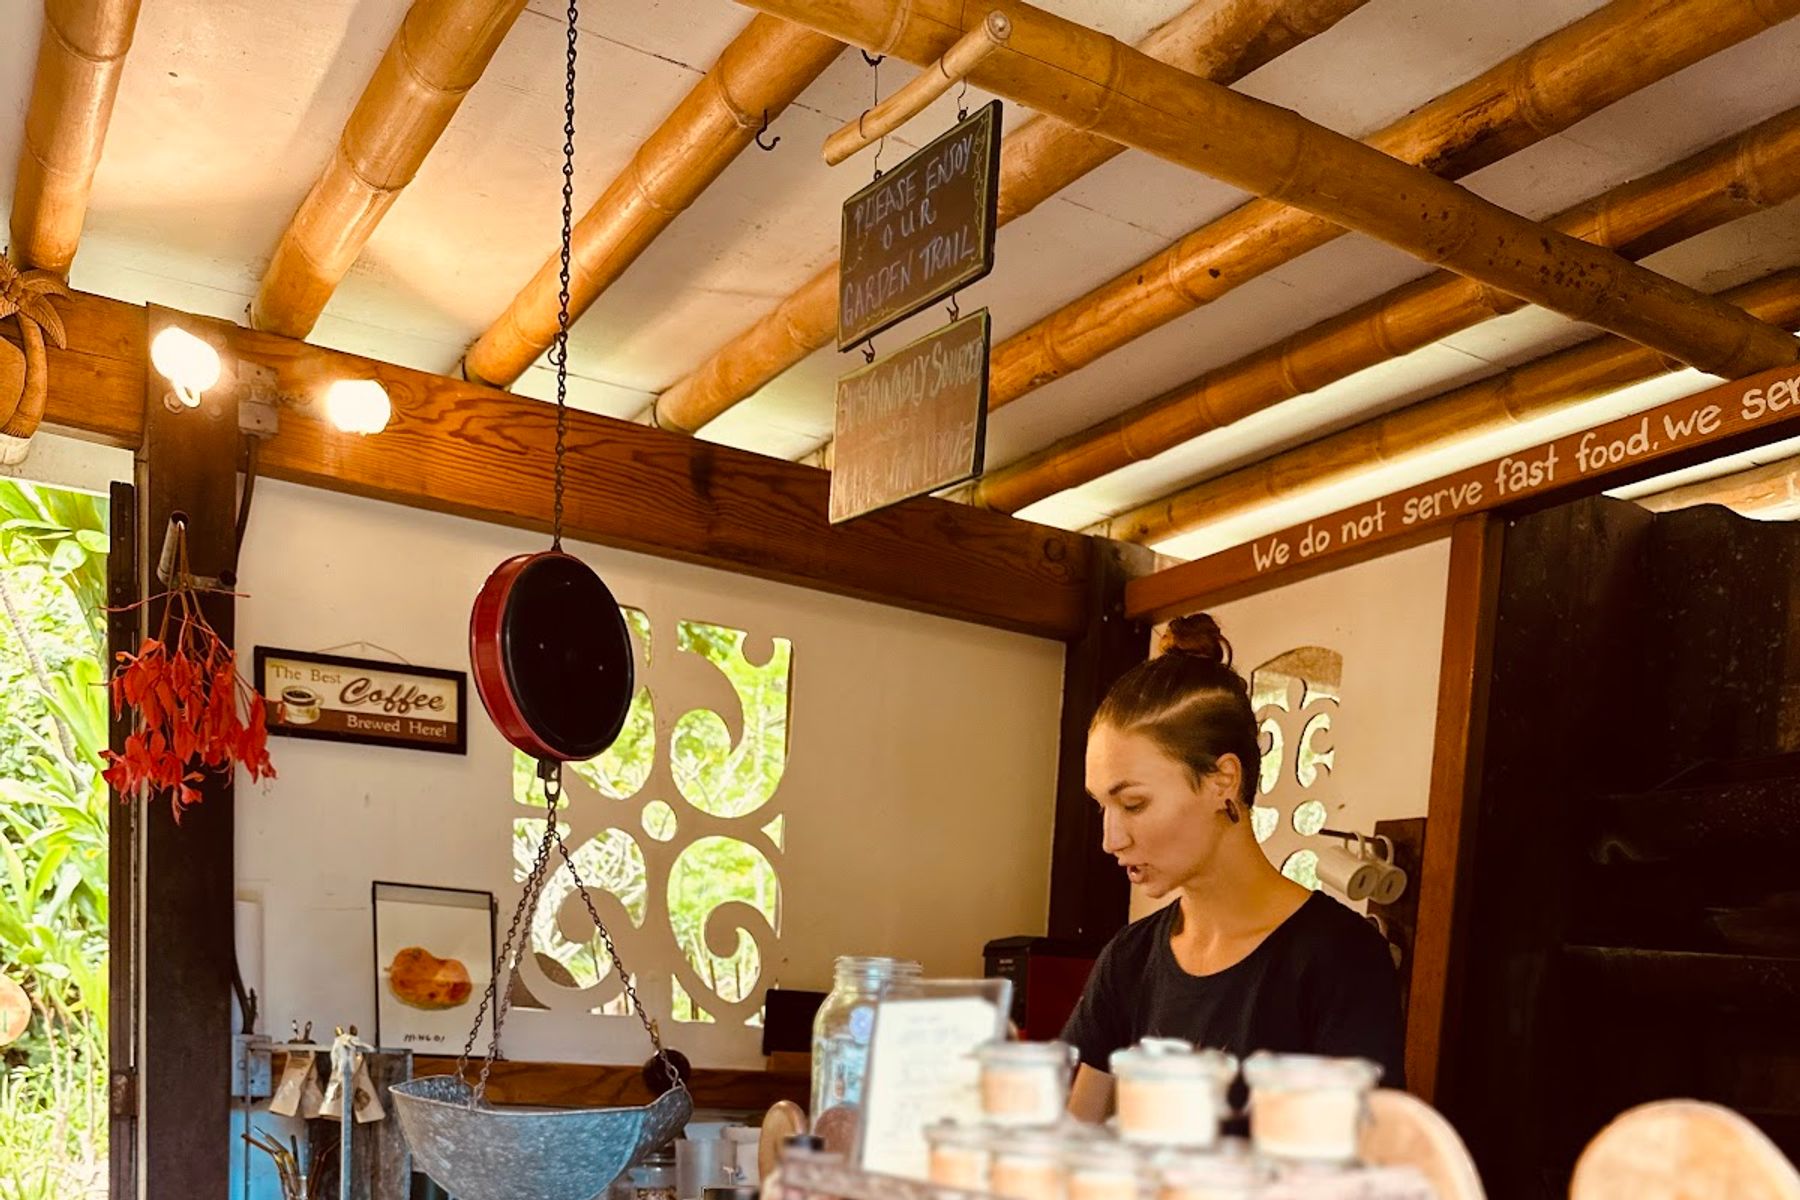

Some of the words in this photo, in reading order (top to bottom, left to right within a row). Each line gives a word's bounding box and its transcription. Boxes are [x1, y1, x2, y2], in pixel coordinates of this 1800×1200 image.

[855, 169, 918, 239] PLEASE
[926, 134, 973, 195] ENJOY
[883, 198, 936, 249] OUR
[844, 249, 914, 327] GARDEN
[919, 225, 975, 280] TRAIL
[1252, 537, 1289, 572] We
[1299, 524, 1330, 557] do
[1341, 501, 1386, 544] not
[1402, 480, 1482, 525] serve
[1494, 443, 1559, 496] fast
[1663, 404, 1722, 441] we
[269, 664, 302, 681] The
[311, 669, 342, 685] Best
[339, 677, 446, 715] Coffee
[346, 713, 401, 733] Brewed
[409, 721, 448, 738] Here!
